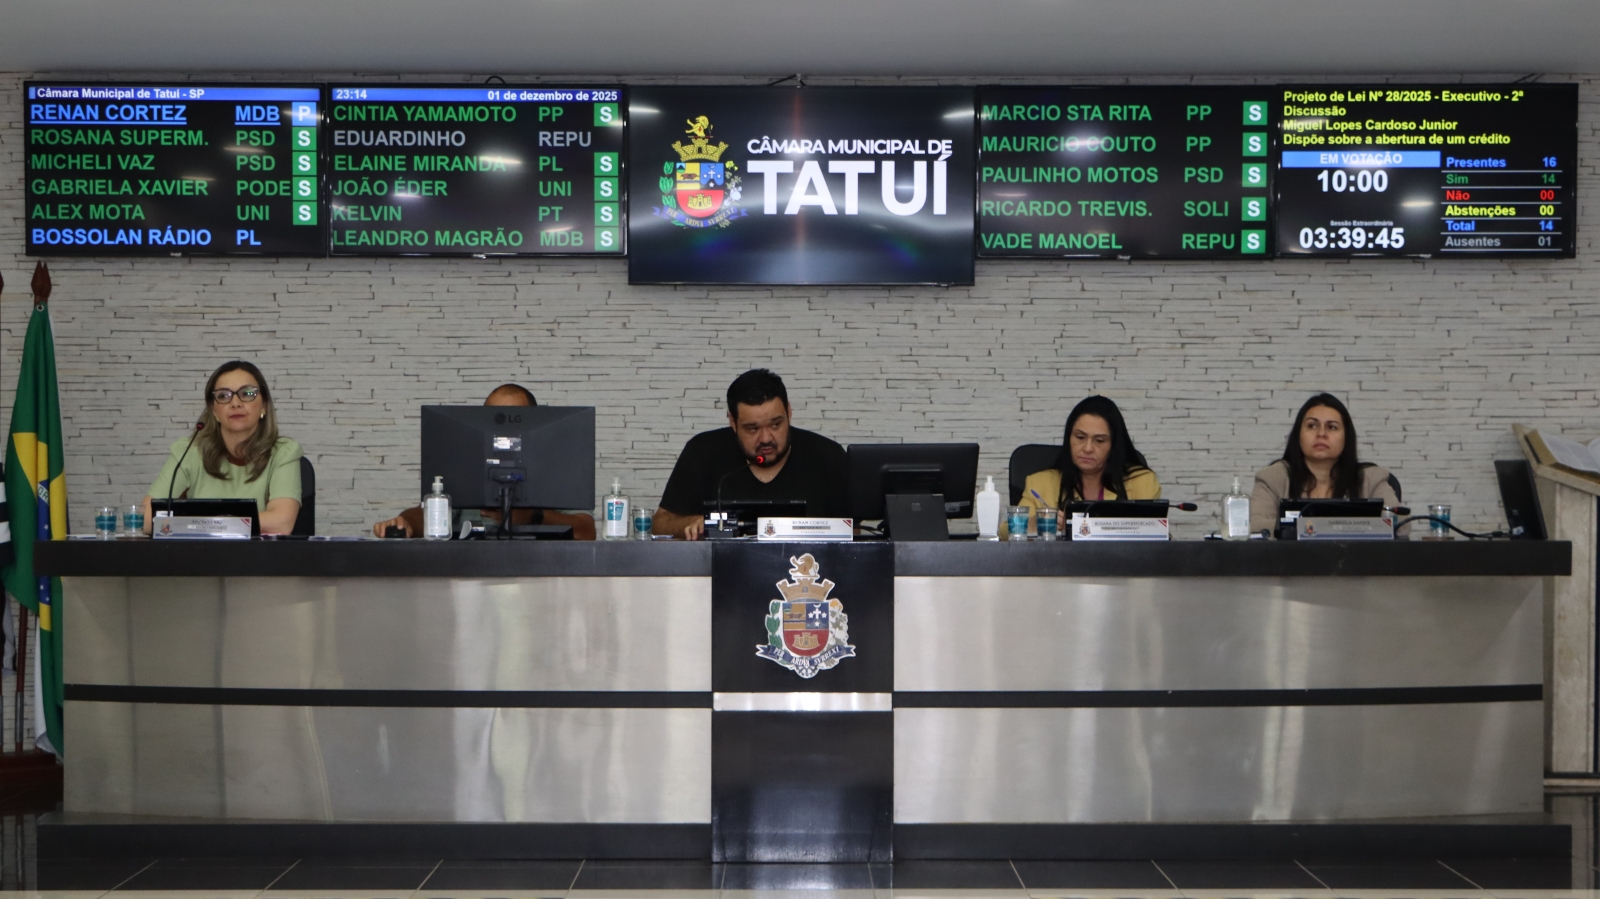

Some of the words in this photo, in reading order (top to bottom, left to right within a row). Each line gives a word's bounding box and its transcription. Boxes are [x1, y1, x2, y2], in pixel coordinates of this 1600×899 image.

[37, 87, 79, 99] Câmara
[81, 87, 135, 100] Municipal
[137, 88, 150, 99] de
[153, 88, 180, 99] Tatuí
[189, 89, 204, 99] SP
[336, 90, 367, 100] 23:14
[488, 91, 500, 100] 01
[504, 91, 517, 100] de
[520, 91, 573, 101] dezembro
[576, 91, 589, 101] de
[592, 91, 618, 101] 2025
[1283, 91, 1327, 104] Projeto
[1330, 91, 1345, 102] de
[1347, 91, 1366, 102] Lei
[1386, 91, 1431, 102] 28/2025
[1442, 91, 1501, 102] Executivo
[31, 105, 99, 121] RENAN
[105, 105, 186, 121] CORTEZ
[235, 106, 280, 121] MDB
[299, 106, 310, 121] P
[334, 106, 398, 122] CINTIA
[404, 106, 516, 122] YAMAMOTO
[539, 108, 563, 122] PP
[600, 107, 612, 122] S
[982, 106, 1061, 120] MARCIO
[1066, 106, 1103, 121] STA
[1109, 106, 1152, 120] RITA
[1186, 106, 1212, 120] PP
[1249, 105, 1262, 121] S
[1283, 105, 1346, 116] Discussão
[1283, 120, 1322, 131] Miguel
[1325, 120, 1362, 132] Lopes
[1365, 120, 1416, 130] Cardoso
[1419, 120, 1458, 130] Junior
[31, 130, 114, 146] ROSANA
[120, 130, 209, 146] SUPERM.
[236, 131, 275, 146] PSD
[297, 131, 310, 146] S
[334, 130, 466, 146] EDUARDINHO
[539, 132, 592, 147] REPU
[747, 135, 825, 155] CÂMARA
[828, 139, 925, 155] MUNICIPAL
[928, 139, 952, 154] DE
[982, 136, 1079, 152] MAURICIO
[1085, 136, 1156, 152] COUTO
[1186, 137, 1212, 152] PP
[1248, 136, 1261, 152] S
[1283, 134, 1325, 147] Dispõe
[1328, 134, 1363, 145] sobre
[1365, 136, 1372, 145] a
[1375, 134, 1425, 145] abertura
[1428, 134, 1444, 145] de
[1447, 136, 1465, 145] um
[1468, 134, 1510, 145] crédito
[31, 155, 112, 170] MICHELI
[117, 155, 154, 170] VAZ
[236, 155, 276, 170] PSD
[298, 155, 311, 171] S
[334, 156, 407, 171] ELAINE
[413, 156, 506, 172] MIRANDA
[539, 157, 563, 172] PL
[600, 156, 612, 172] S
[1320, 154, 1341, 164] EM
[1342, 152, 1402, 166] VOTAÇÃO
[1446, 157, 1506, 168] Presentes
[1542, 158, 1556, 167] 16
[982, 167, 1081, 182] PAULINHO
[1087, 167, 1158, 183] MOTOS
[1184, 168, 1224, 183] PSD
[1248, 167, 1261, 183] S
[1317, 170, 1388, 192] 10:00
[1446, 174, 1468, 184] Sim
[1542, 174, 1556, 184] 14
[31, 180, 132, 195] GABRIELA
[138, 180, 208, 195] XAVIER
[236, 181, 291, 196] PODE
[298, 180, 311, 196] S
[334, 178, 388, 196] JOÃO
[395, 178, 448, 196] ÉDER
[539, 182, 571, 197] UNI
[600, 181, 612, 197] S
[747, 155, 954, 215] TATUÍ
[1446, 191, 1470, 201] Não
[1540, 191, 1554, 201] 00
[32, 204, 83, 220] ALEX
[89, 204, 145, 220] MOTA
[237, 205, 270, 221] UNI
[298, 205, 311, 221] S
[334, 206, 402, 221] KELVIN
[539, 206, 563, 222] PT
[600, 206, 613, 222] S
[982, 201, 1071, 216] RICARDO
[1078, 201, 1152, 216] TREVIS.
[1184, 201, 1229, 217] SOLI
[1248, 200, 1260, 217] S
[1446, 206, 1516, 217] Abstenções
[1540, 206, 1554, 216] 00
[1446, 221, 1475, 232] Total
[1540, 222, 1553, 231] 14
[32, 229, 142, 245] BOSSOLAN
[148, 226, 211, 245] RÁDIO
[236, 230, 261, 245] PL
[334, 230, 428, 246] LEANDRO
[434, 228, 523, 246] MAGRÃO
[540, 232, 583, 247] MDB
[600, 231, 613, 247] S
[982, 234, 1032, 248] VADE
[1039, 234, 1122, 249] MANOEL
[1182, 234, 1235, 250] REPU
[1247, 234, 1259, 250] S
[1300, 228, 1404, 249] 03:39:45
[1445, 236, 1501, 247] Ausentes
[1538, 237, 1551, 247] 01
[509, 415, 522, 423] LG
